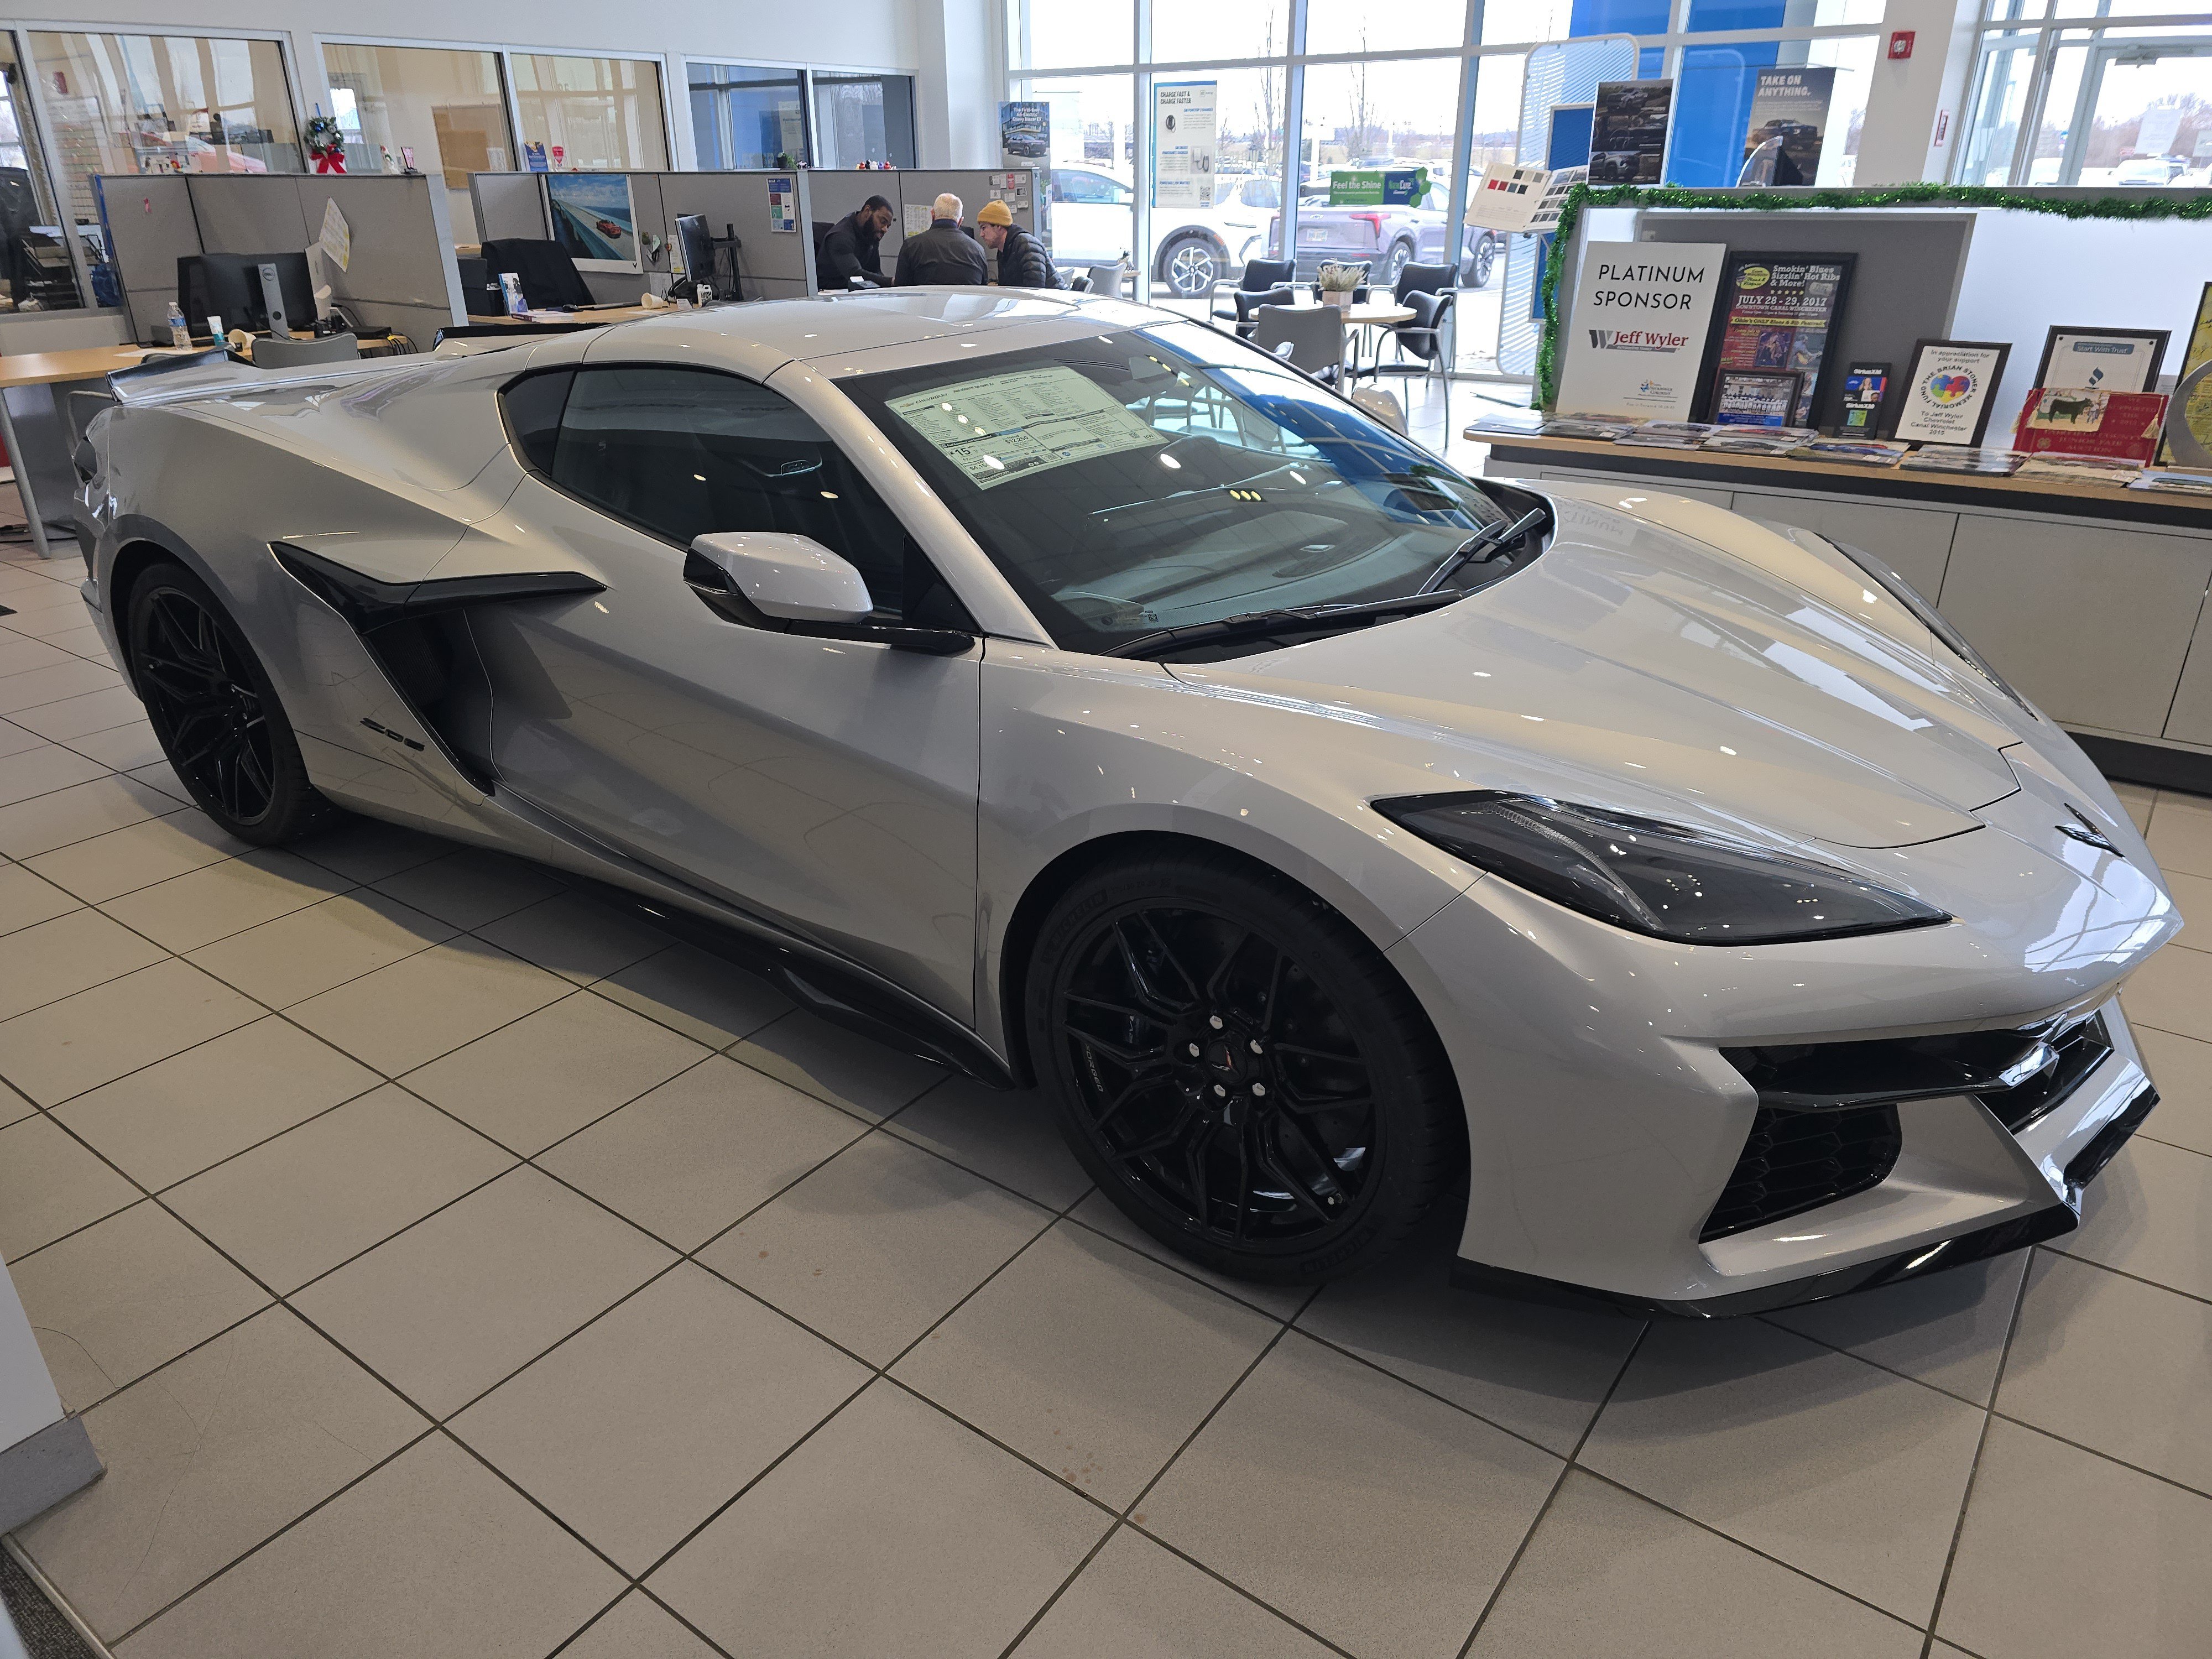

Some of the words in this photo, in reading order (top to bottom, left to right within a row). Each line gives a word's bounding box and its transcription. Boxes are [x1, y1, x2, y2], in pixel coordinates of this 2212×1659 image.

[1760, 75, 1786, 86] TAKE
[1787, 75, 1802, 85] ON
[1758, 86, 1811, 97] ANYTHING.
[1333, 181, 1348, 190] Feel
[1349, 180, 1361, 189] the
[1361, 180, 1382, 189] Shine
[1599, 264, 1705, 283] PLATINUM
[1593, 291, 1691, 310] SPONSOR
[1738, 295, 1764, 304] JULY
[1765, 296, 1777, 305] 28
[1785, 297, 1800, 306] 29,
[1803, 298, 1828, 306] 2017
[1613, 331, 1643, 345] Jeff
[1645, 333, 1689, 350] Wyler
[1922, 371, 1936, 385] THE
[1963, 368, 1978, 393] STONER
[915, 393, 948, 404] CHEVROLET
[1921, 387, 1932, 404] FUND
[1931, 394, 1973, 410] MEMORIAL
[955, 447, 971, 456] 15
[1050, 890, 1105, 948] MICHELIN
[1085, 1044, 1104, 1093] FORGED
